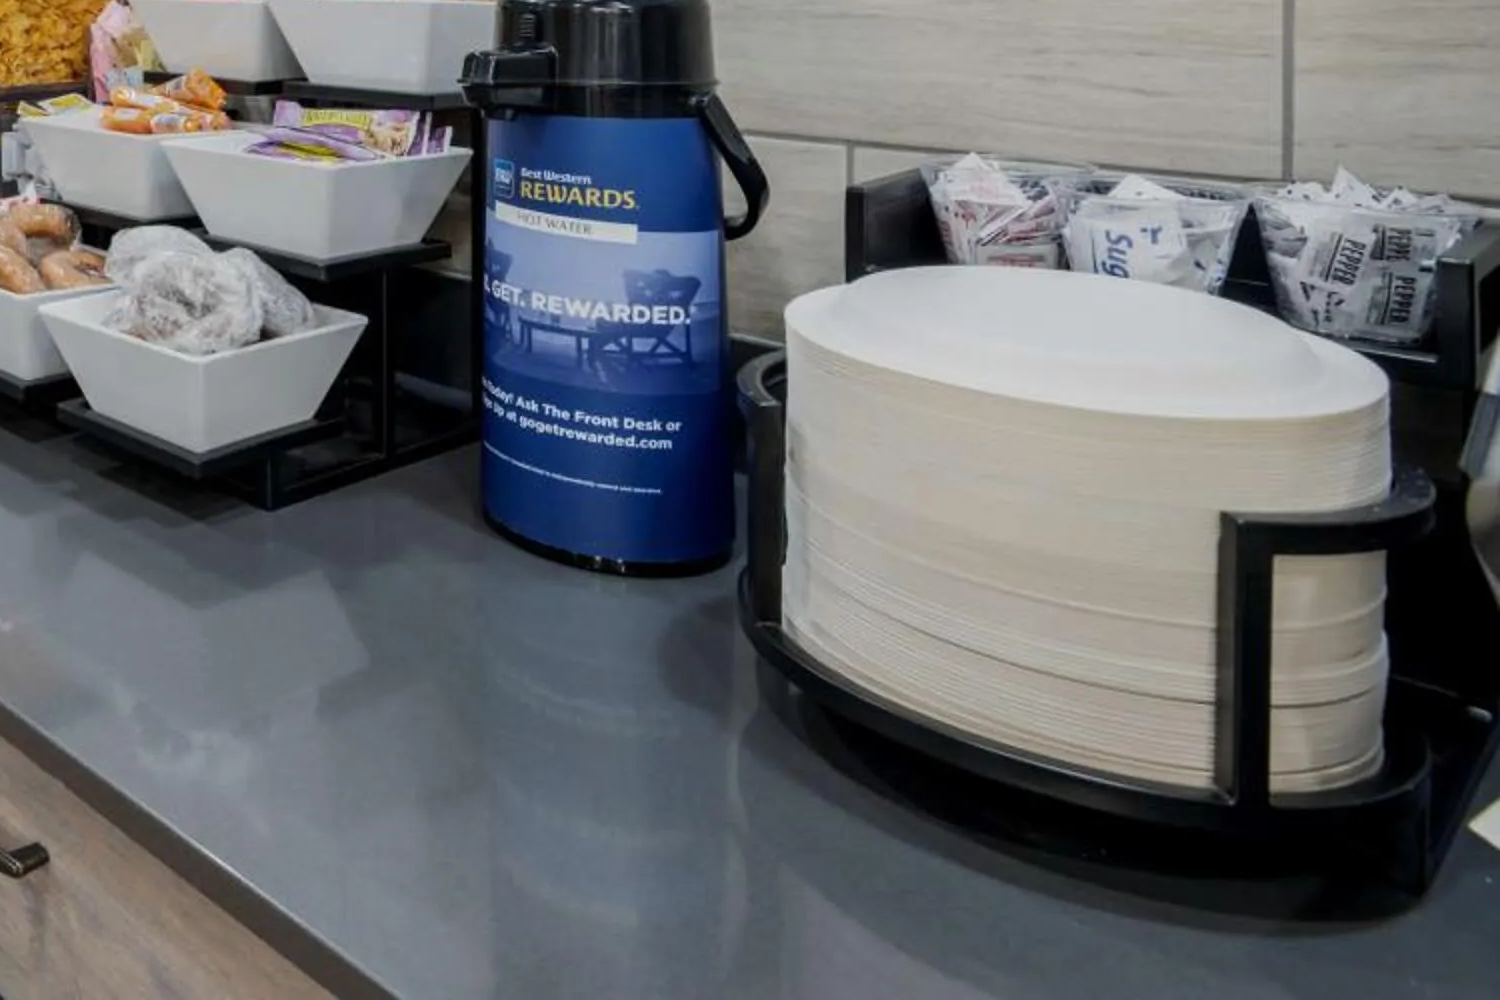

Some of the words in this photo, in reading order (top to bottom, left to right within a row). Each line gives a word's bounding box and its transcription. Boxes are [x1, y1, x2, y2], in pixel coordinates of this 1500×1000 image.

[521, 167, 542, 180] Best
[544, 170, 592, 185] Western
[517, 211, 541, 226] HOT
[546, 218, 592, 235] WATER
[1101, 230, 1133, 278] Sug
[1330, 238, 1367, 286] PEPPER
[1385, 226, 1413, 262] PEPPE
[531, 291, 691, 325] REWARDED.
[1389, 275, 1418, 324] PEPPER
[515, 396, 539, 413] Ask
[541, 403, 570, 421] The
[574, 411, 619, 430] Front
[623, 418, 663, 432] Desk
[665, 421, 683, 433] or
[520, 416, 673, 450] gogetrewarded.com
